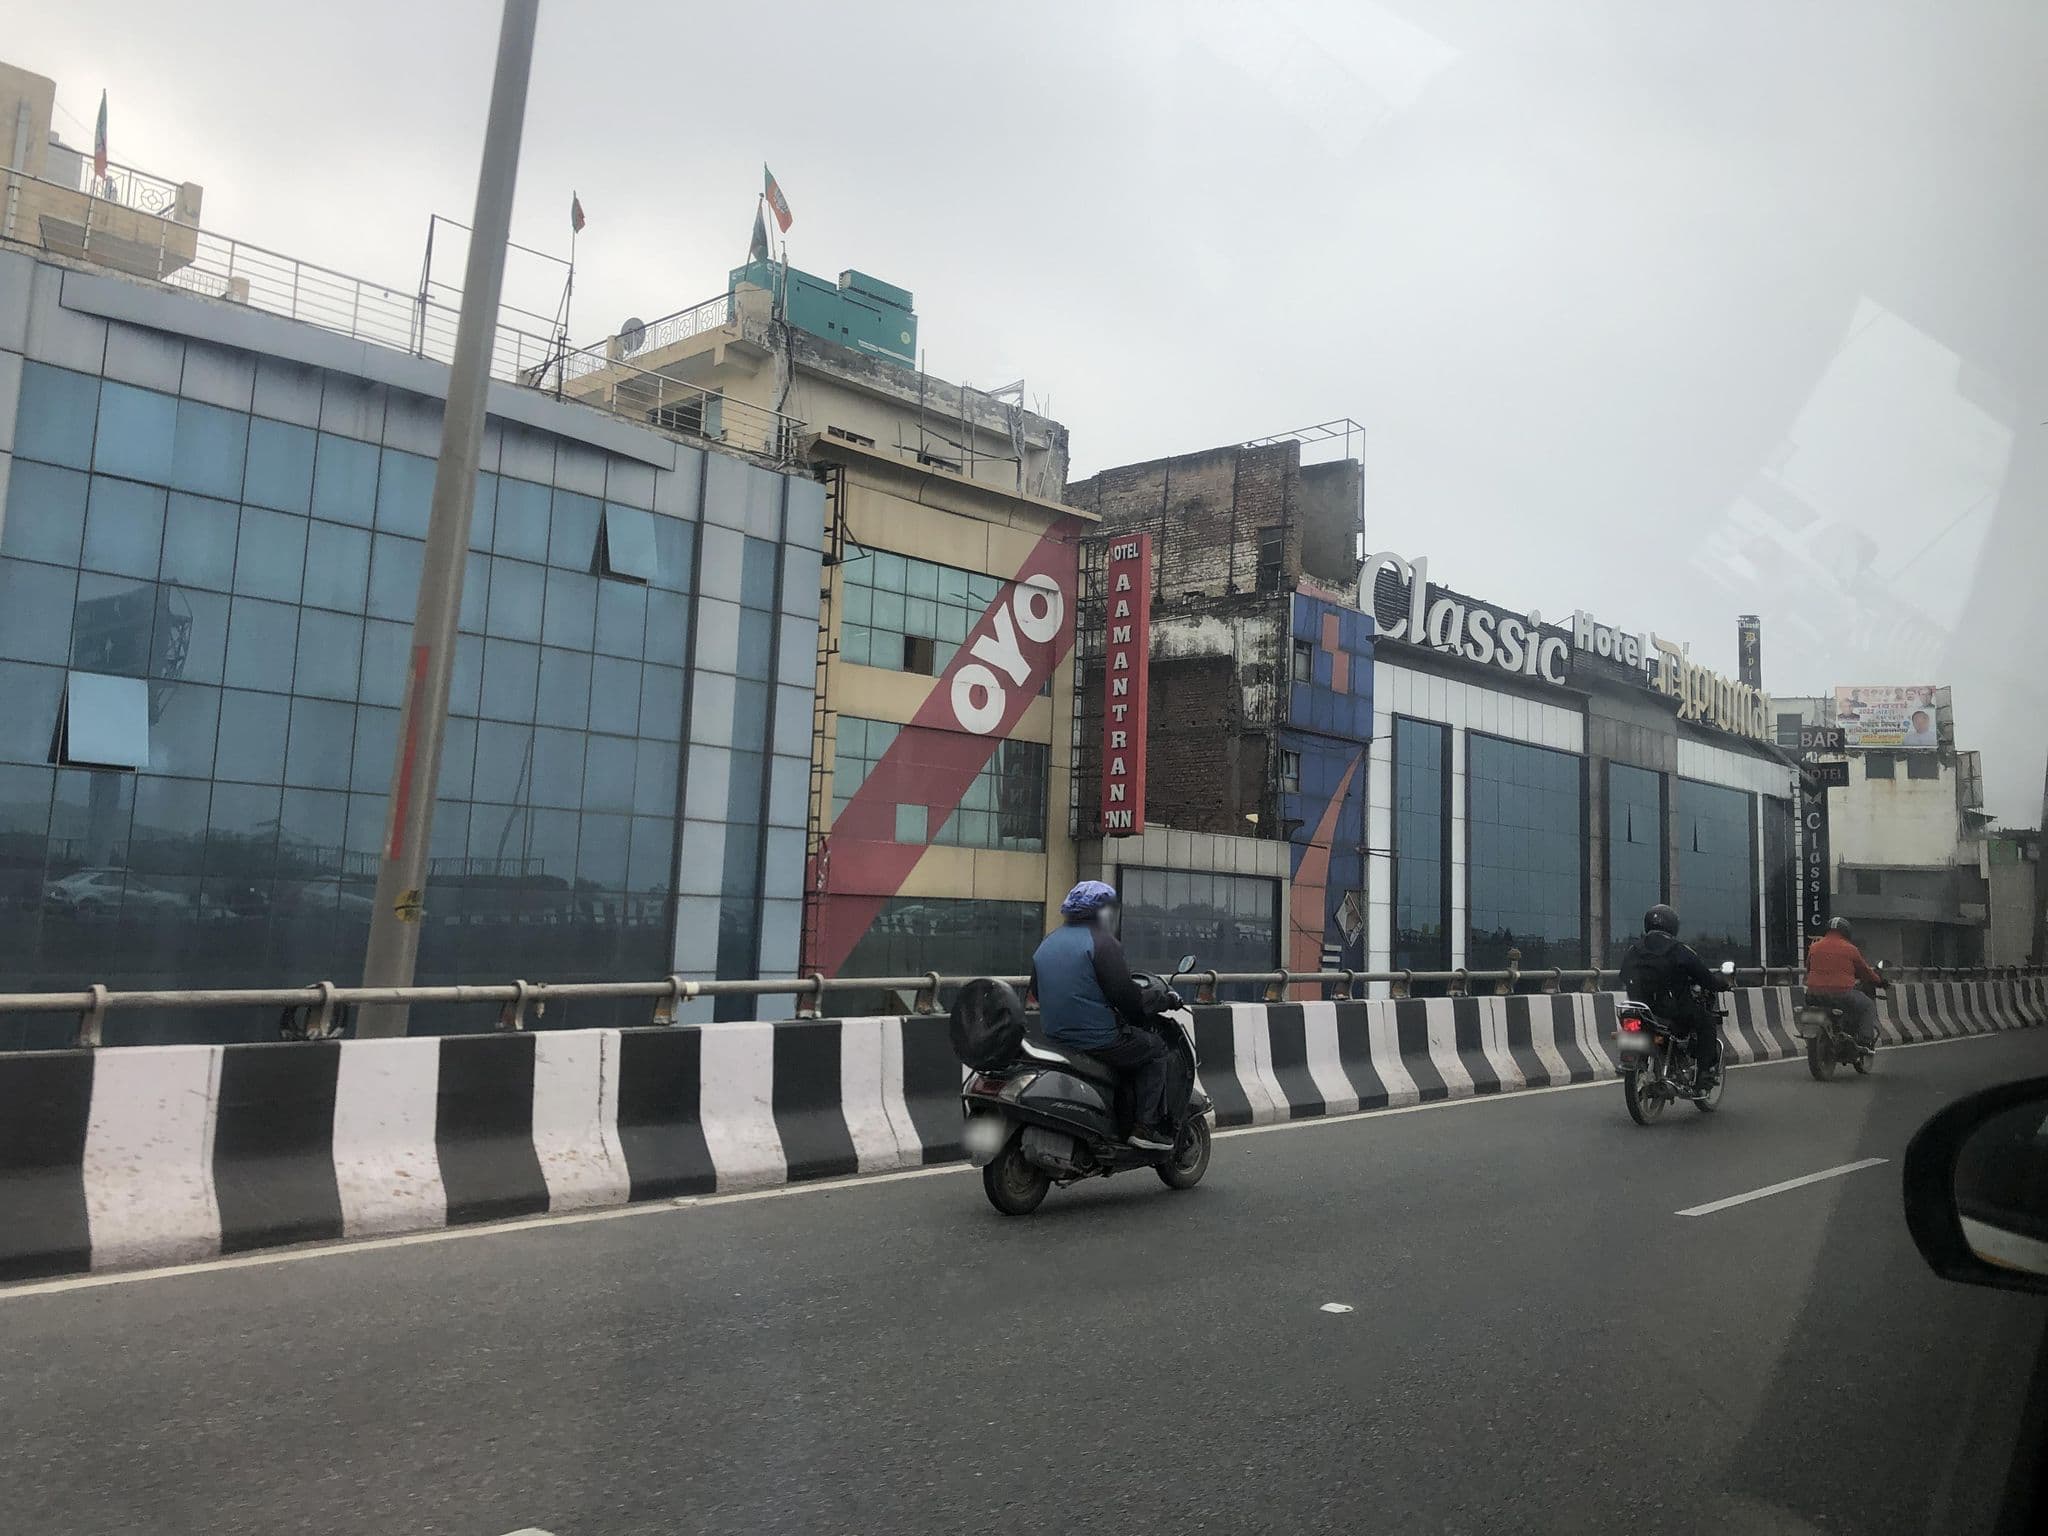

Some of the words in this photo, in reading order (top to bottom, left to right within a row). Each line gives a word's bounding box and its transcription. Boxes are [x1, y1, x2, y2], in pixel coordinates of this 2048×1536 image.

[951, 574, 1064, 734] OYO
[1357, 551, 1568, 685] Classic
[1574, 609, 1649, 671] Hotel
[1110, 573, 1132, 802] AAMANTRAN
[1801, 731, 1839, 748] BAR
[1806, 812, 1822, 926] Classic
